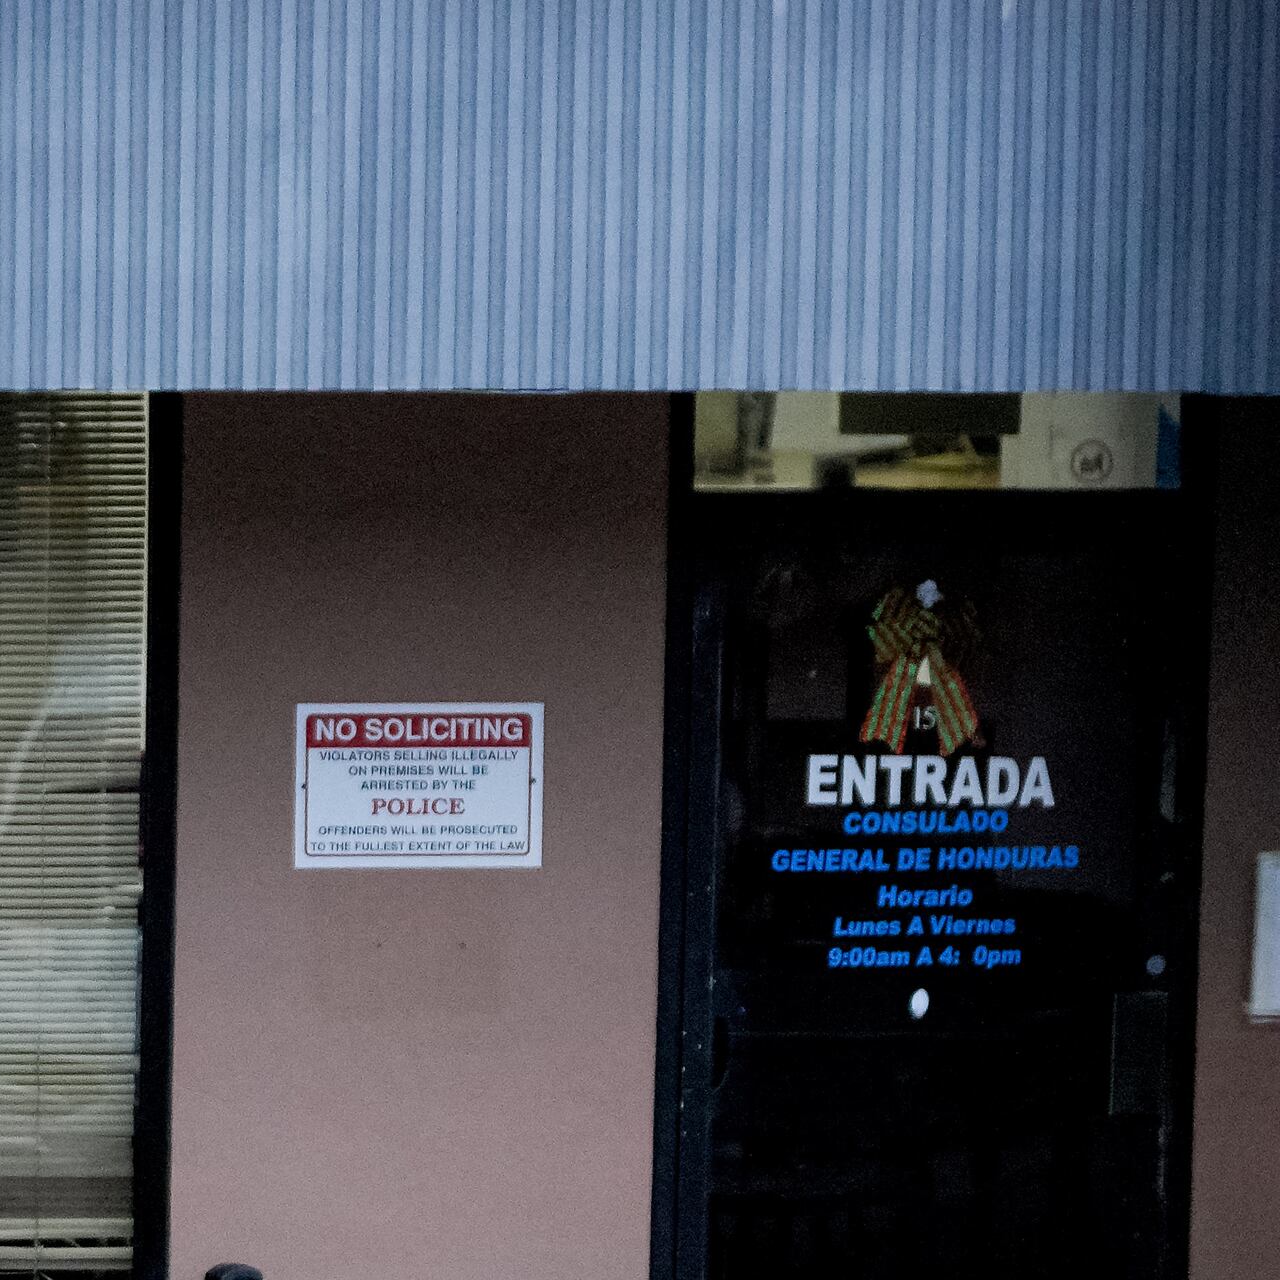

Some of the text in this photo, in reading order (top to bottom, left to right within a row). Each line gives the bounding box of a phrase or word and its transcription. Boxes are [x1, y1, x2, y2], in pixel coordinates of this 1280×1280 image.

[315, 717, 524, 742] NO SOLICITING
[319, 750, 519, 761] VIOLATORS SELLING ILLEGALLY
[348, 765, 489, 776] ON PREMISES WILL BE
[806, 753, 1056, 808] ENTRADA
[360, 780, 476, 791] ARRESTED BY THE
[370, 797, 466, 816] POLICE
[318, 824, 519, 836] OFFENDERS WILL BE PROSECUTED
[843, 810, 1009, 835] CONSULADO
[310, 841, 525, 851] TO THE FULLEST EXTENT OF THE LAW
[771, 846, 1080, 873] GENERAL DE HONDURAS
[877, 884, 974, 907] Horario
[832, 914, 1017, 937] Lunes A Viernes
[827, 946, 911, 969] 9:00am
[915, 946, 934, 967] A
